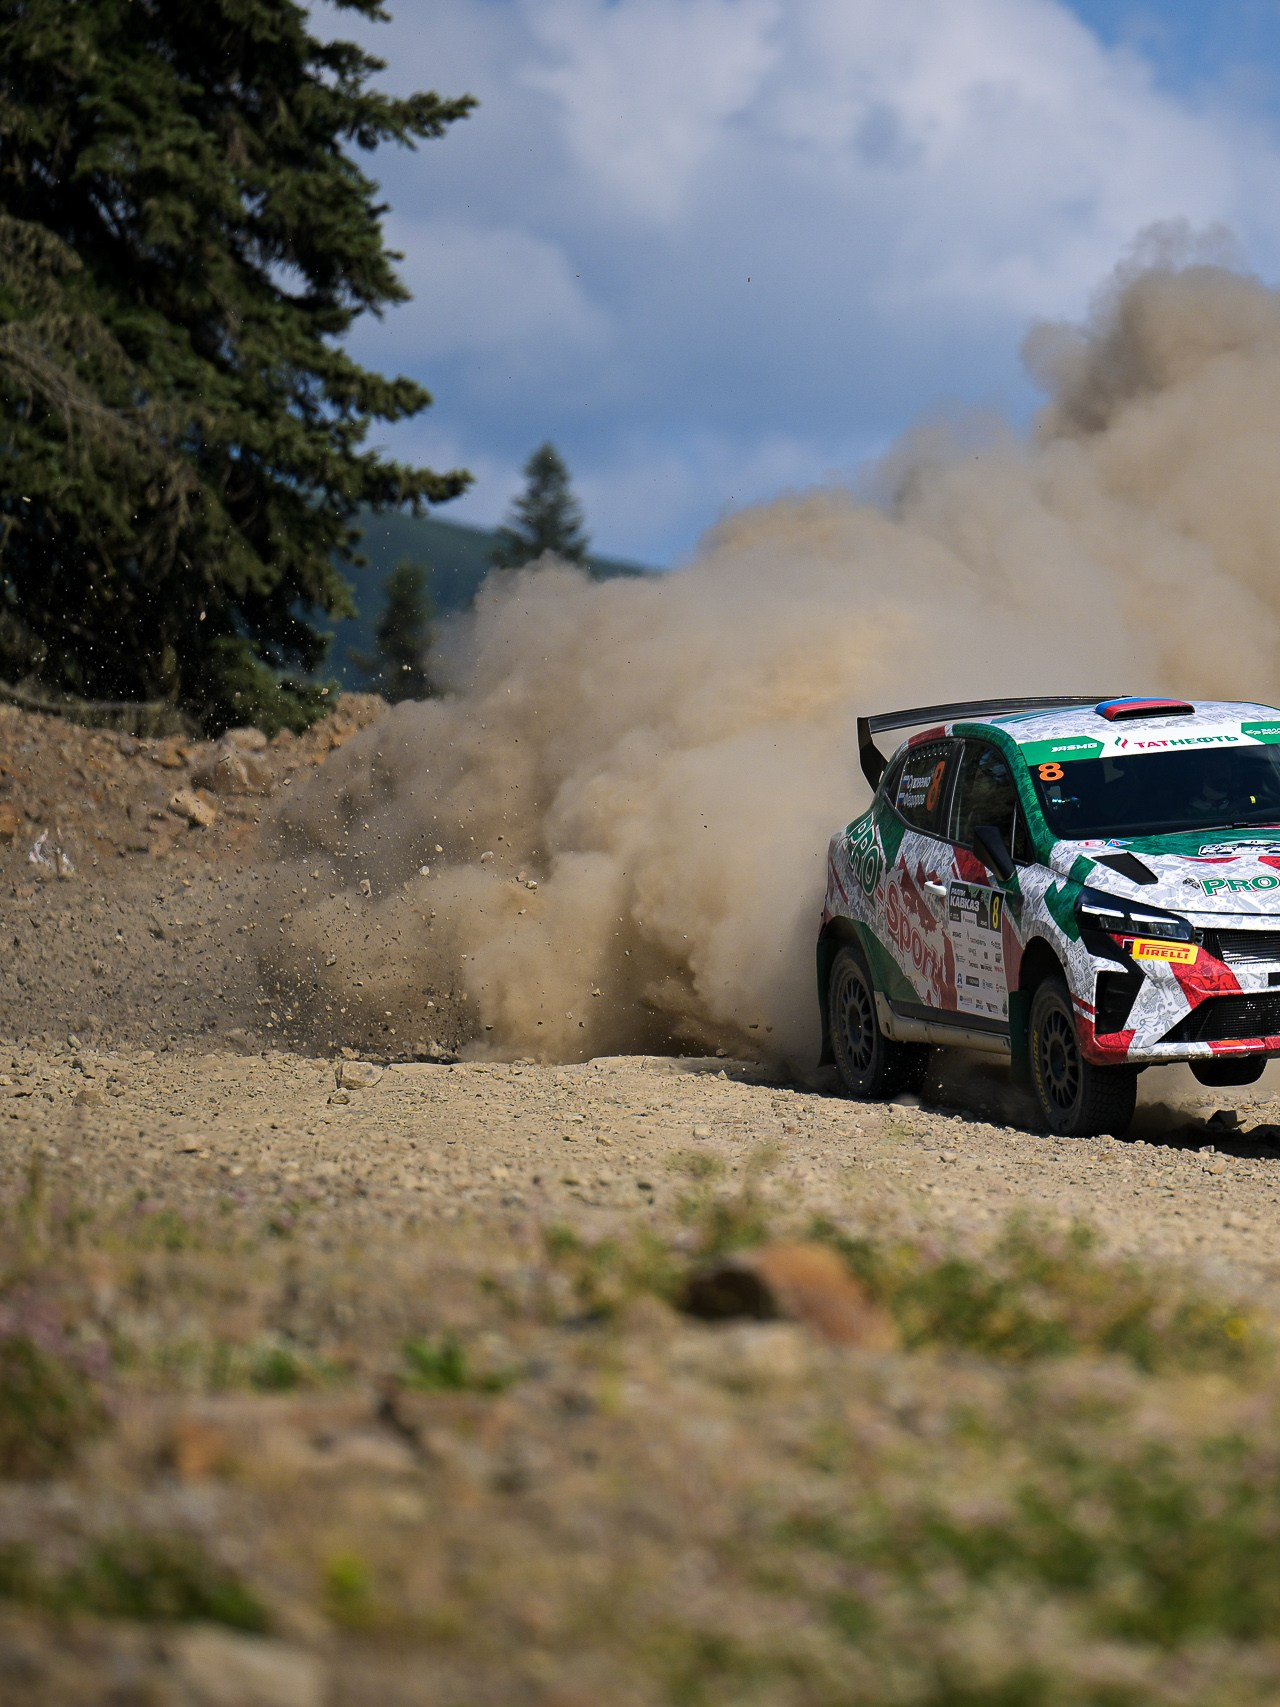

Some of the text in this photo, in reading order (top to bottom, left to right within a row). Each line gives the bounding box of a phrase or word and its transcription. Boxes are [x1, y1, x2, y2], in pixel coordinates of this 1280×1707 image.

[1134, 735, 1239, 749] ТАТНЕФТЬ
[1038, 762, 1065, 781] 8
[927, 761, 946, 811] 8
[950, 895, 980, 912] КАВКАЗ
[992, 895, 1000, 929] 8
[1138, 943, 1191, 959] PIRELLI
